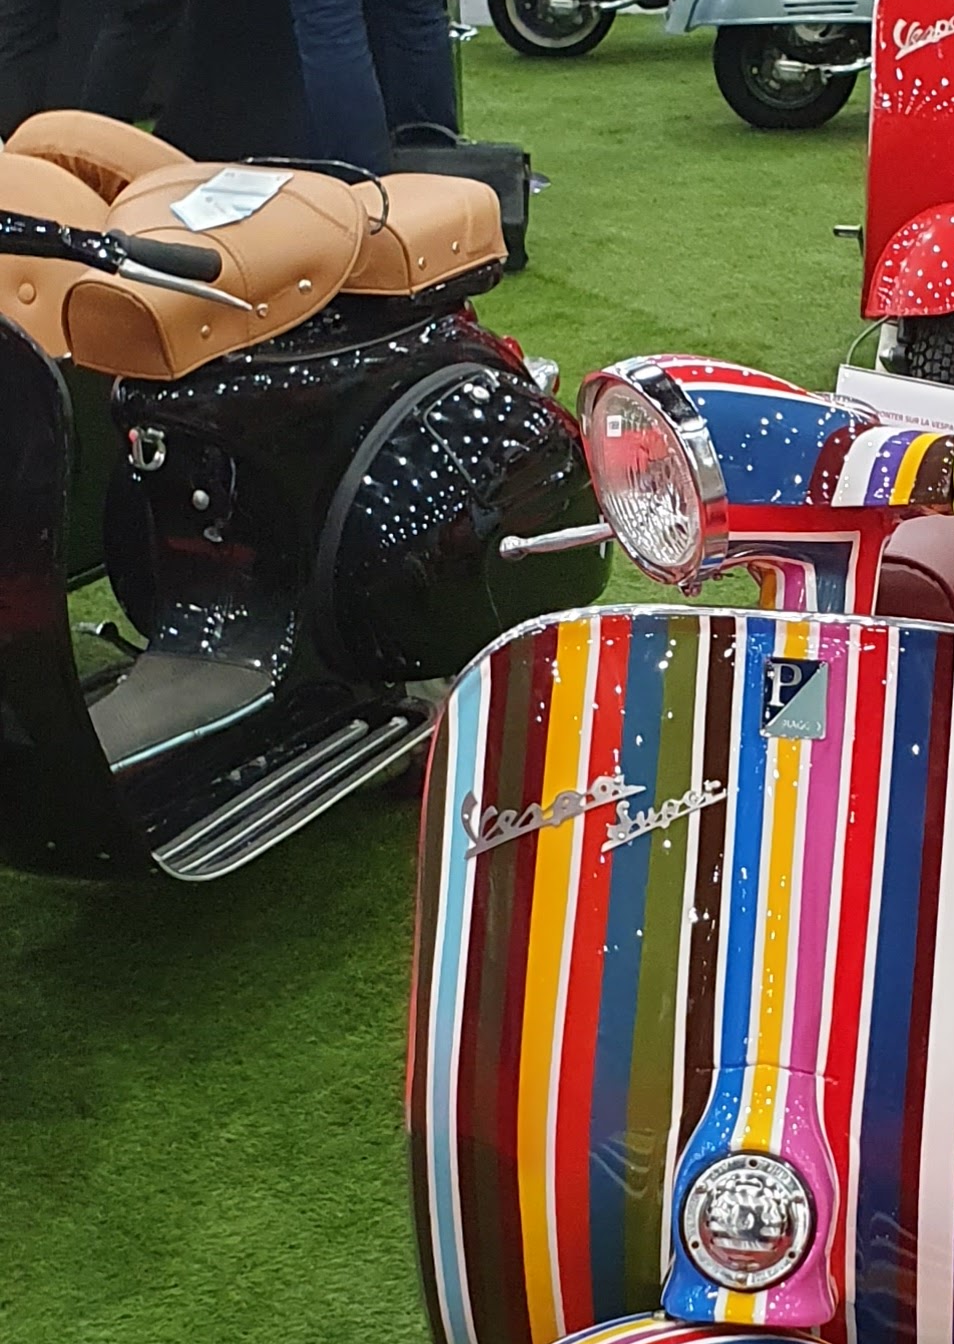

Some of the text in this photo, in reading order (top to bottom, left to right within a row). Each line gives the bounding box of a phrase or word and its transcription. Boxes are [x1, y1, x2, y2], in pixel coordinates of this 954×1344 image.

[768, 662, 803, 707] P
[461, 773, 647, 861] Vespa
[601, 779, 728, 854] Super
